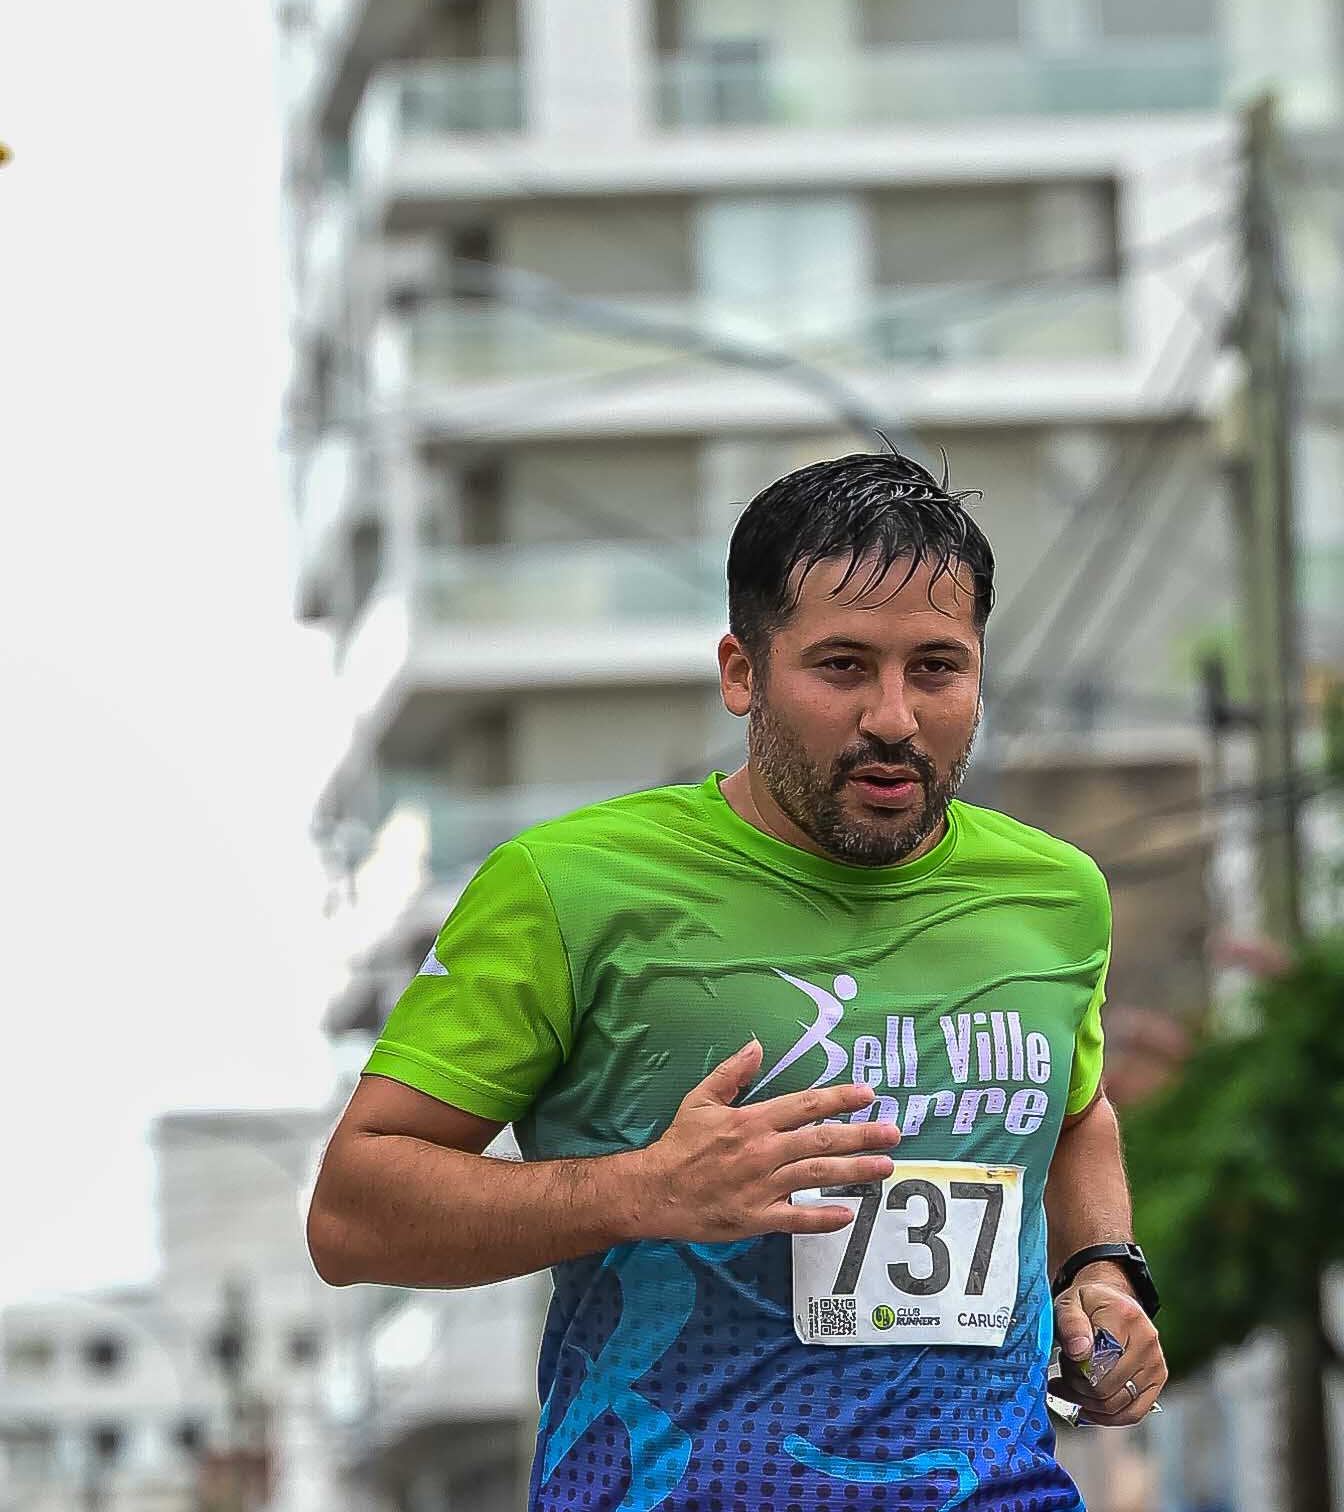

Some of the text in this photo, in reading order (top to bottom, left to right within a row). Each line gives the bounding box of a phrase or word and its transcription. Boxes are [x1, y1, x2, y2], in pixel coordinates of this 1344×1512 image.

[939, 1011, 1051, 1084] Ville
[816, 1087, 1049, 1136] orre
[820, 1178, 1004, 1296] 737
[896, 1307, 921, 1317] CLUB
